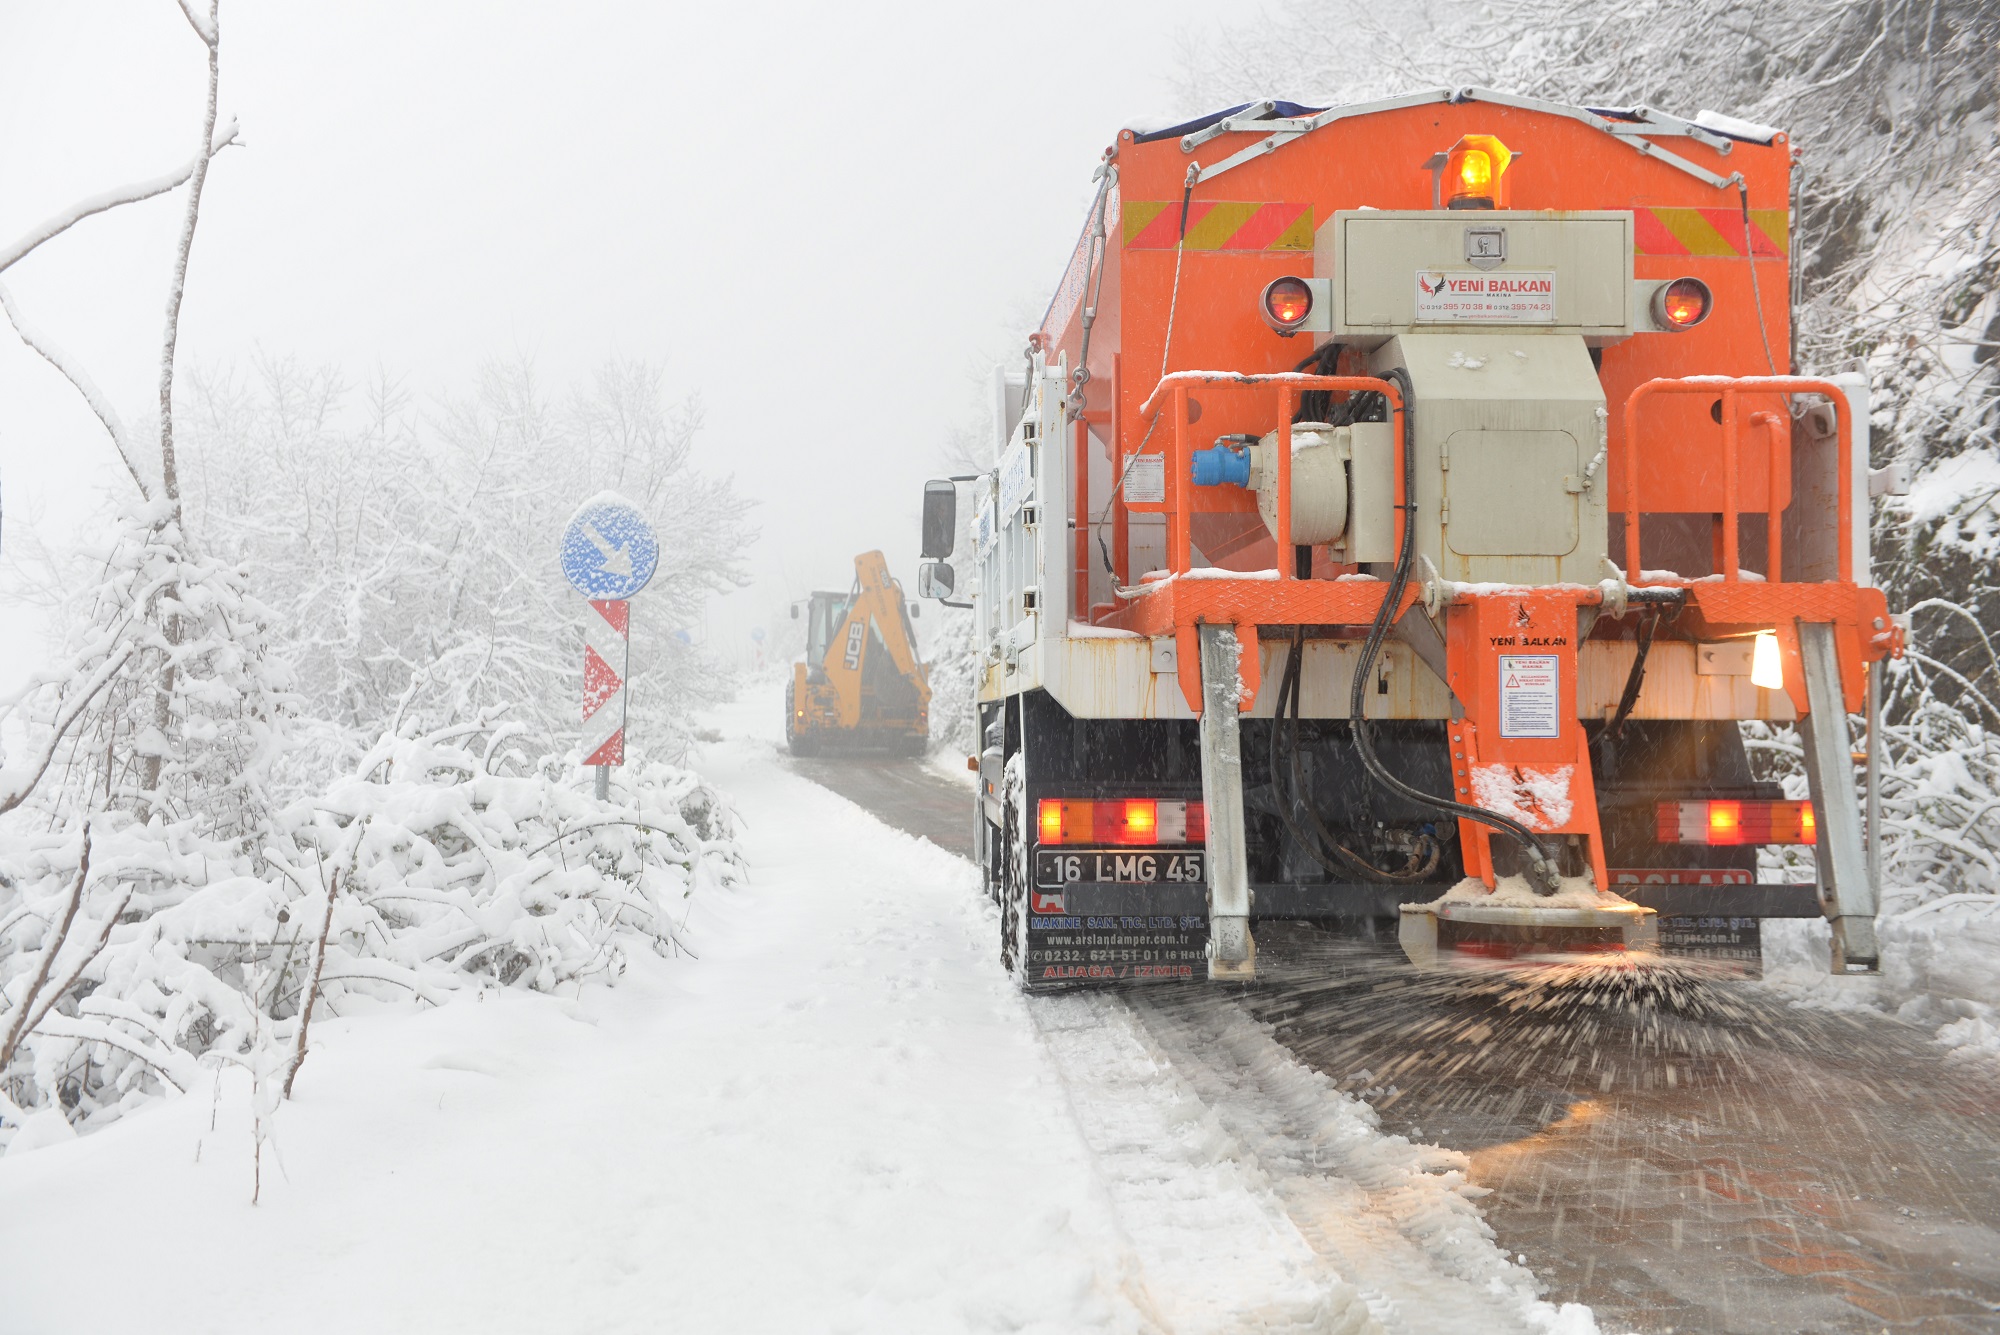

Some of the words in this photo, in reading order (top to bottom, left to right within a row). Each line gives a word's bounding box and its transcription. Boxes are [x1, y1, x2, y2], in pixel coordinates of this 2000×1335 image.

[1488, 280, 1551, 292] BALKAN
[844, 623, 864, 670] JCB
[1522, 637, 1567, 646] BALKAN
[1053, 855, 1081, 882] 16
[1096, 855, 1157, 882] LMG
[1166, 855, 1201, 882] 45
[1086, 917, 1118, 929] SAN.
[1148, 917, 1177, 929] LTD.
[1047, 934, 1189, 947] www.arslandamper.com.tr
[1090, 950, 1116, 961] 621
[1121, 950, 1137, 961] 51
[1143, 950, 1159, 961] 01
[1165, 950, 1177, 960] (6
[1180, 950, 1205, 960] Hat)
